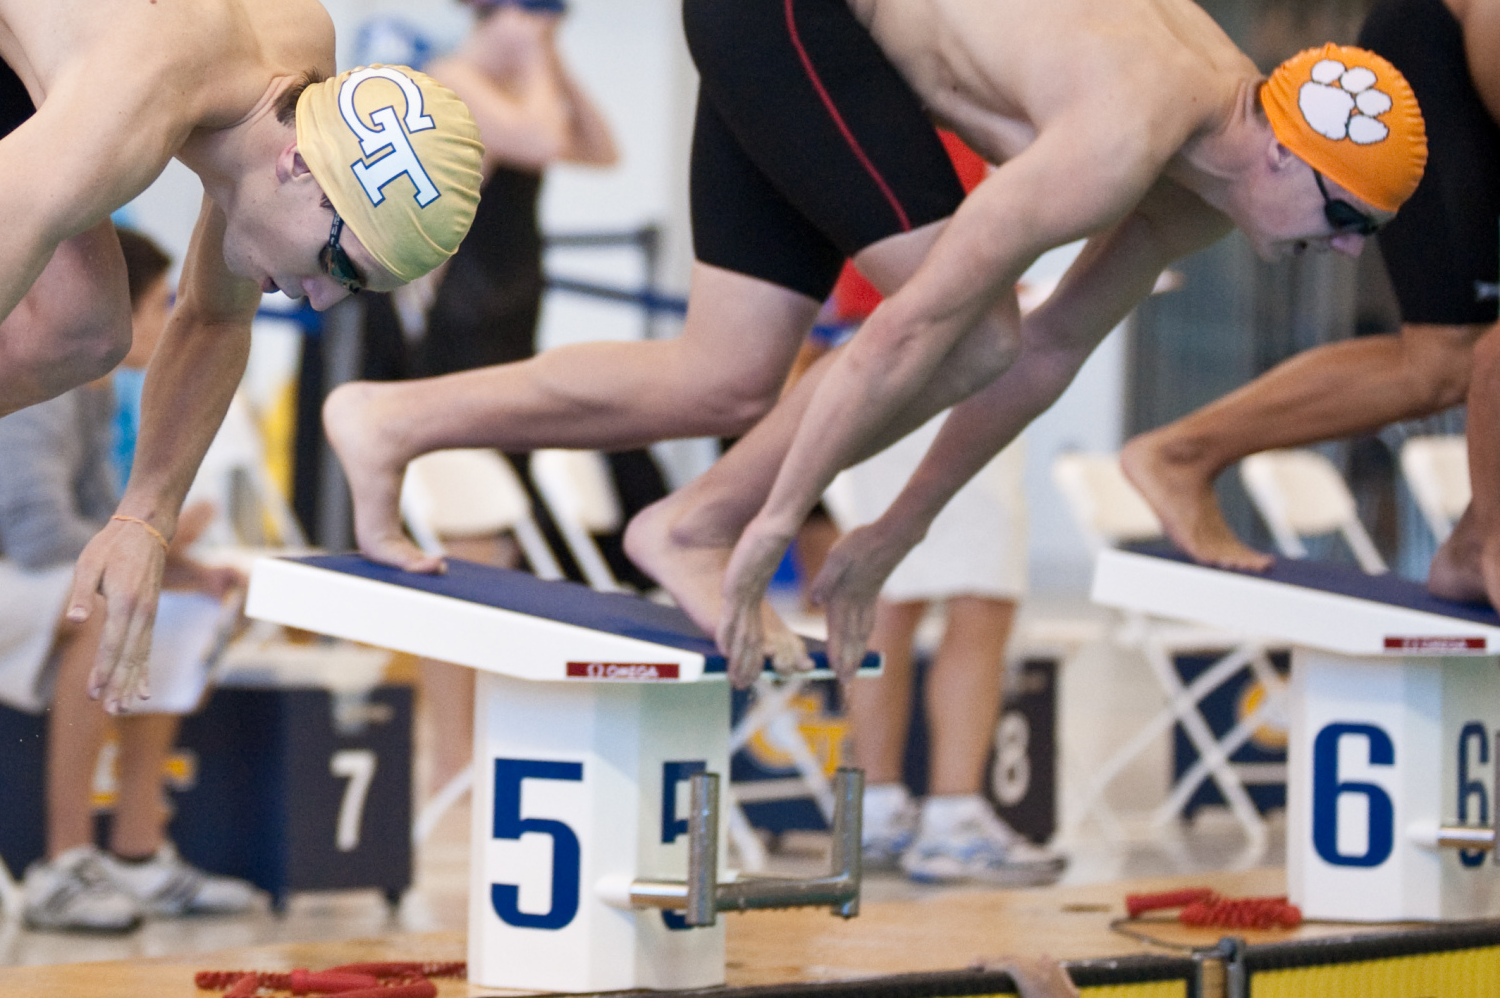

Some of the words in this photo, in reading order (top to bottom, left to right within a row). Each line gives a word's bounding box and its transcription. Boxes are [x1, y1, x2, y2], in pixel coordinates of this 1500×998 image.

[337, 67, 441, 209] GT
[329, 749, 378, 853] 7
[993, 712, 1031, 807] 8
[1311, 721, 1395, 869] 6
[1458, 721, 1489, 868] 6
[490, 757, 583, 931] 5
